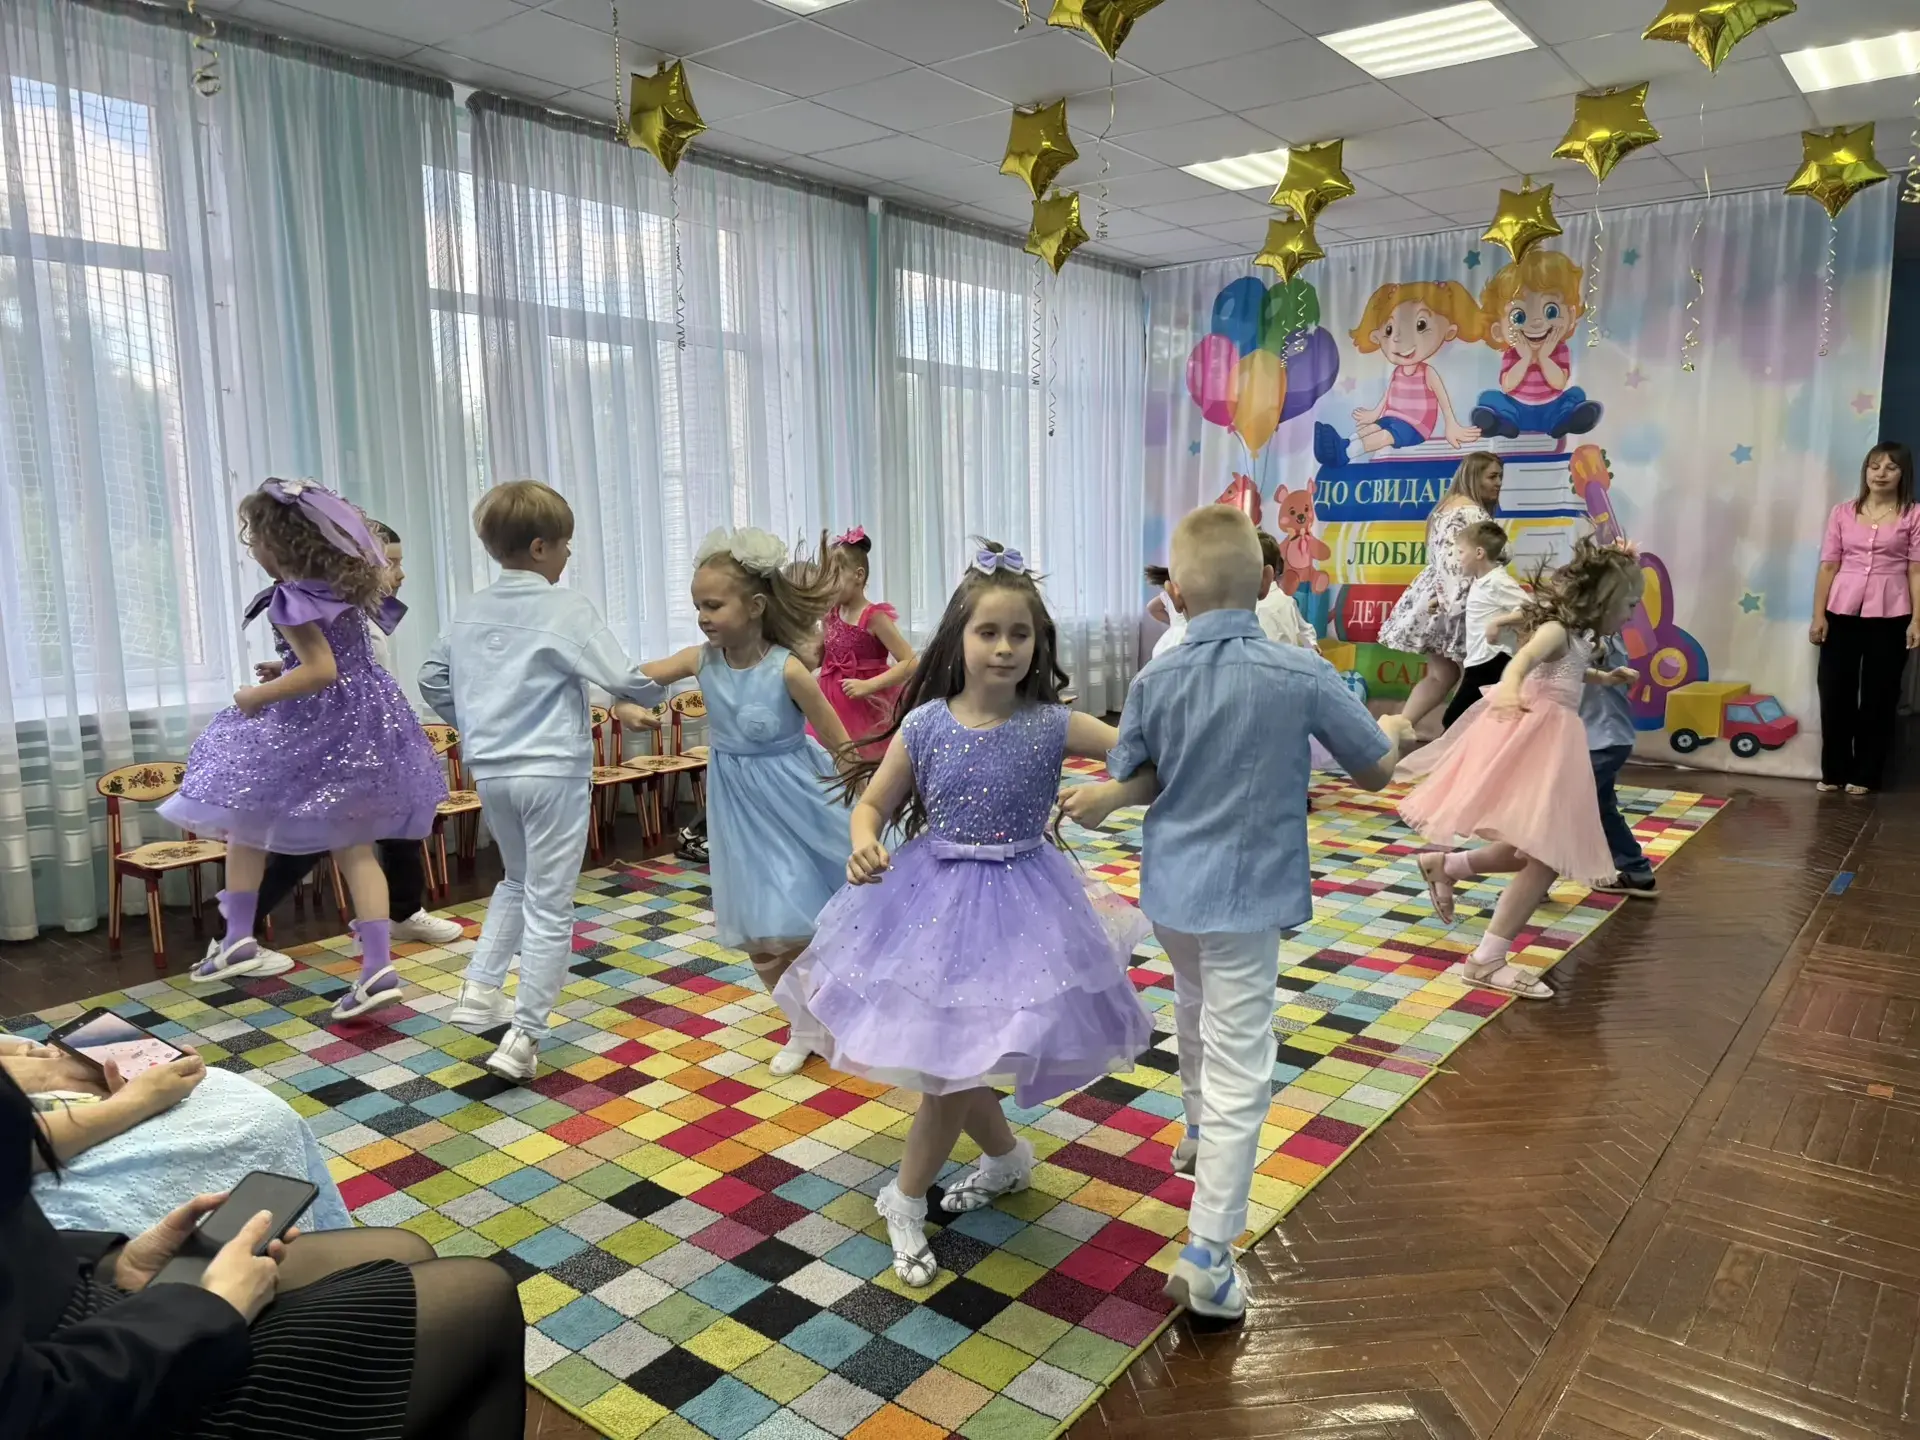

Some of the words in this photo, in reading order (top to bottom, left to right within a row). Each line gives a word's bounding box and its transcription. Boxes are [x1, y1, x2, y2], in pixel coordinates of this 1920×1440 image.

[1314, 480, 1348, 510] ДО
[1347, 541, 1427, 565] ЛЮБИ
[1348, 600, 1393, 629] ДЕТ
